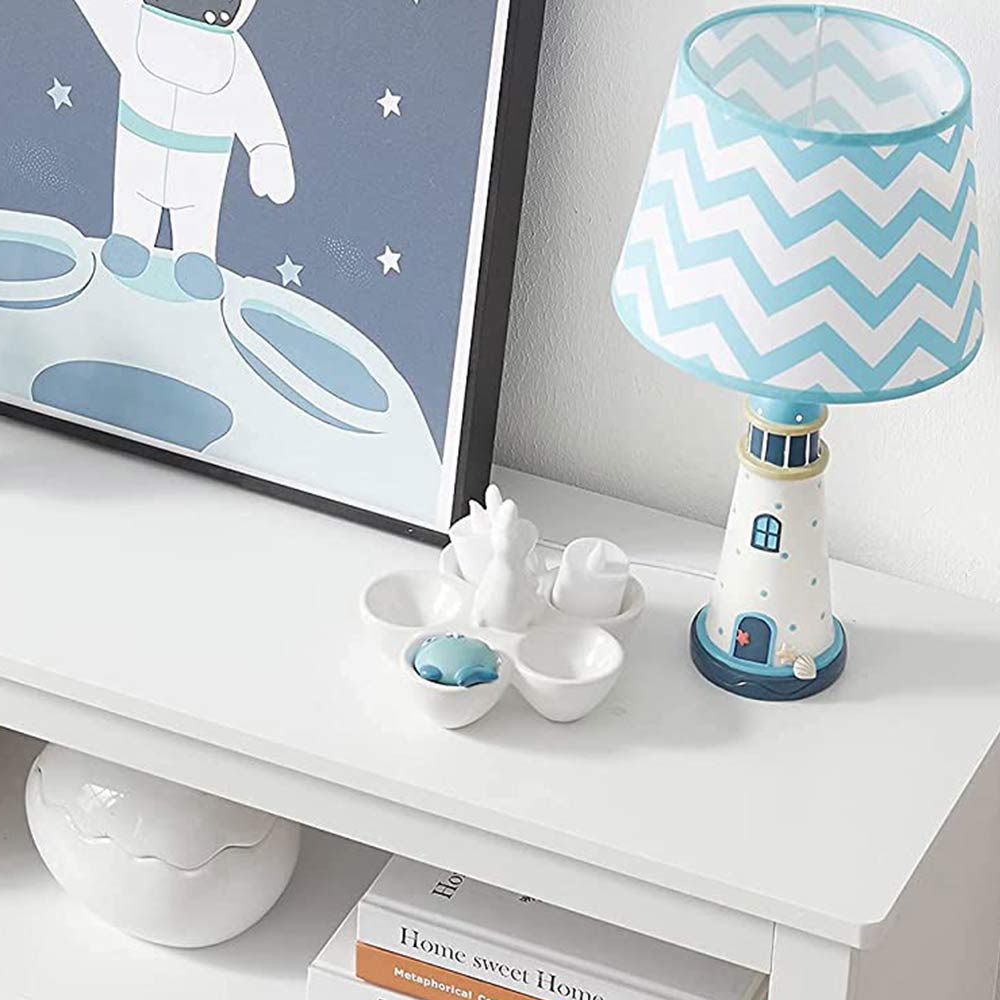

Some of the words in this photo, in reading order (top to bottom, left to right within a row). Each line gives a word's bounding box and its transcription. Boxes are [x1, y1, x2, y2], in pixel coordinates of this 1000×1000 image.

[432, 872, 465, 899] Ho
[400, 926, 466, 963] Home
[473, 956, 529, 984] sweet
[393, 967, 472, 999] Metaphorical
